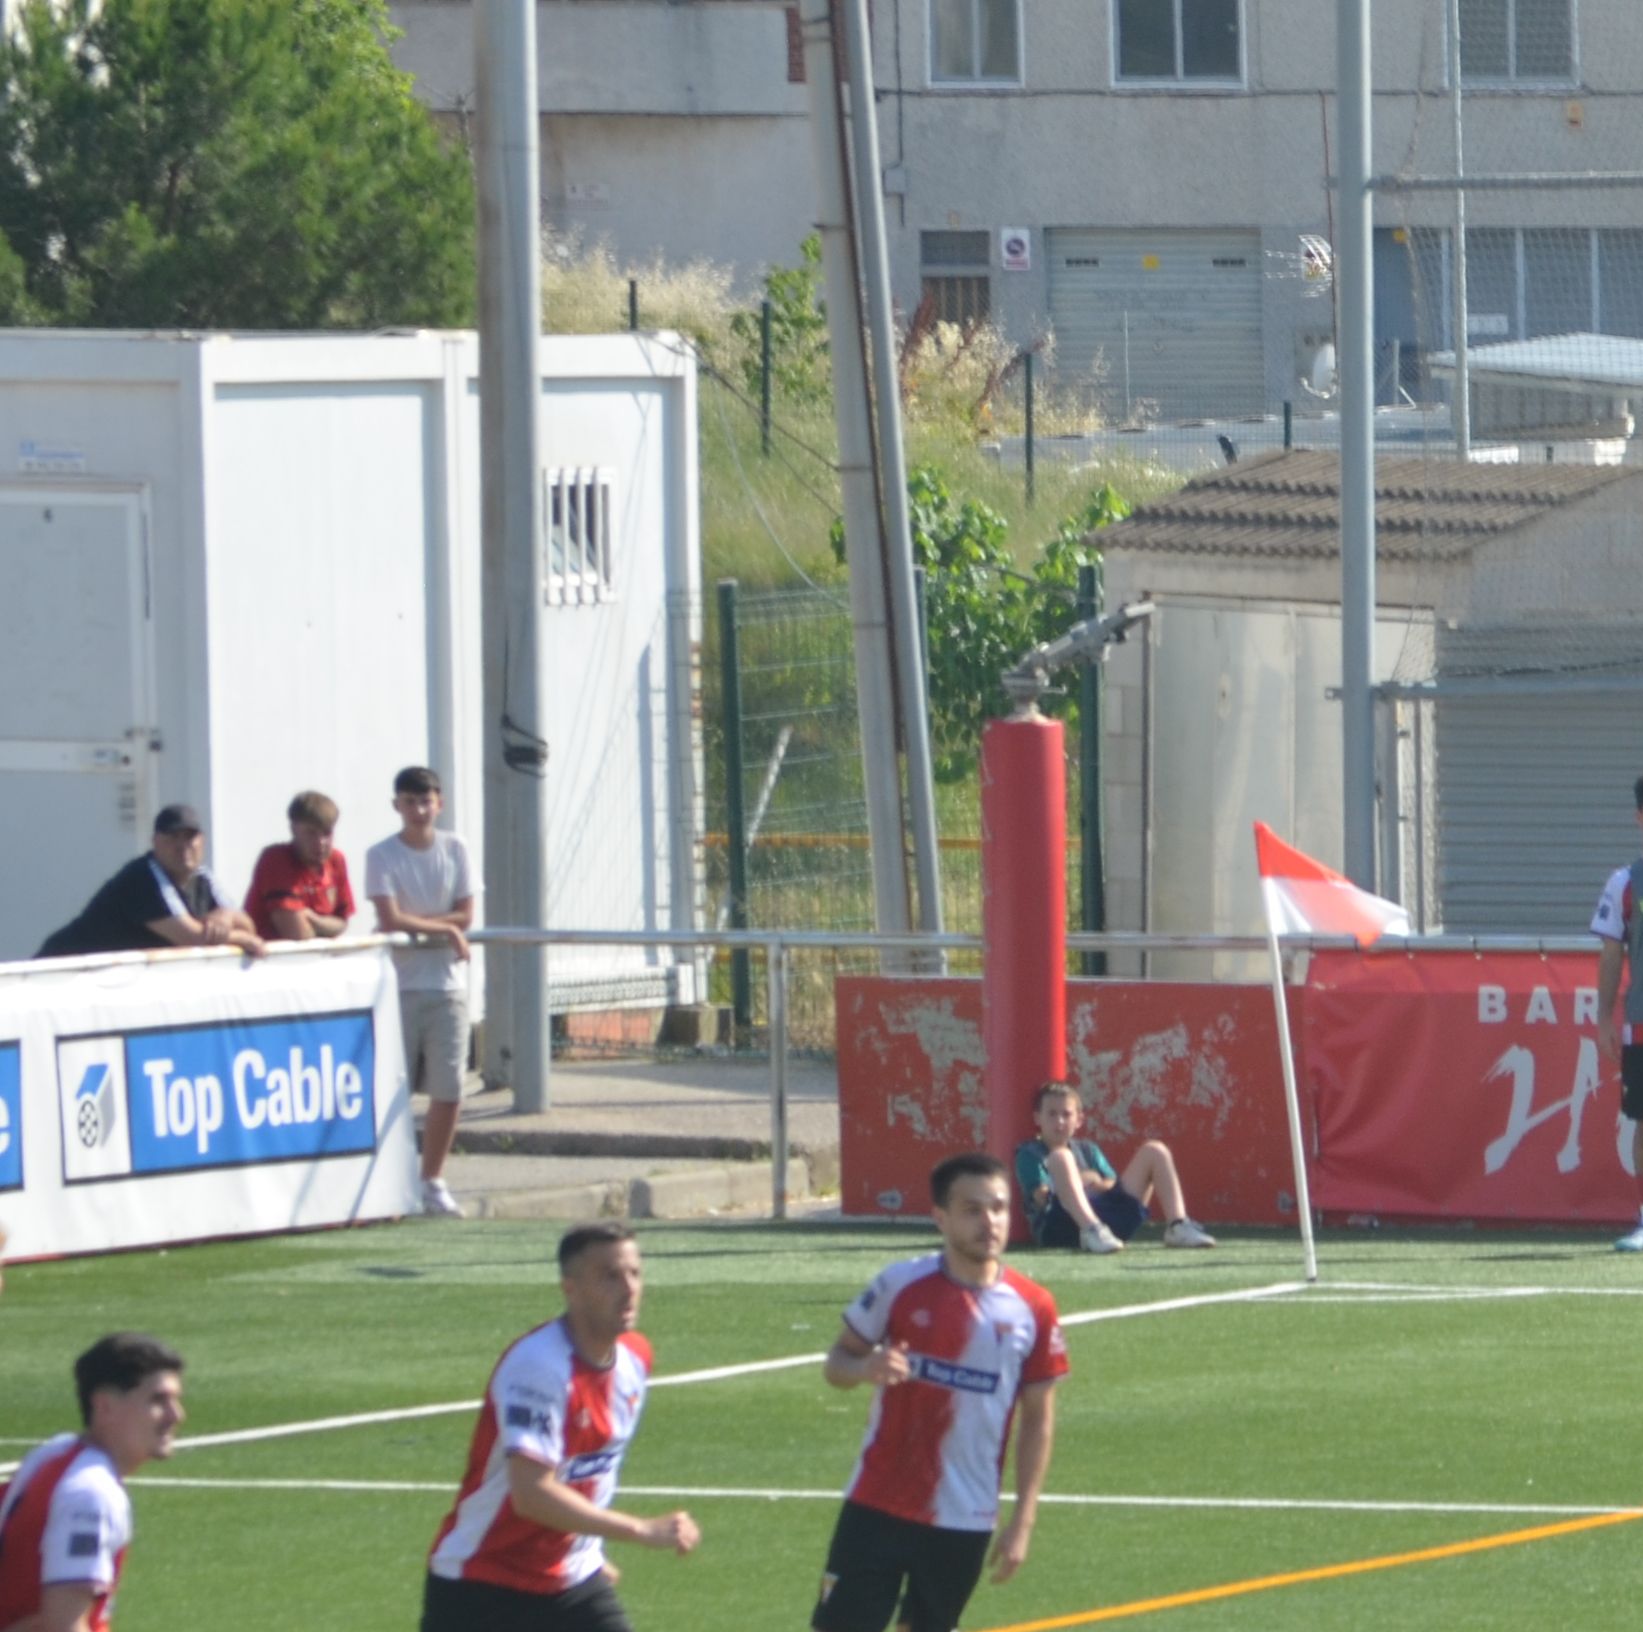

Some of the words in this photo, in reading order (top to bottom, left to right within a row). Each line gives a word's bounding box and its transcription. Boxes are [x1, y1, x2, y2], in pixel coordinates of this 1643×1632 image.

[1477, 985, 1601, 1025] BAR
[142, 1058, 224, 1155] Top
[232, 1044, 363, 1131] Cable
